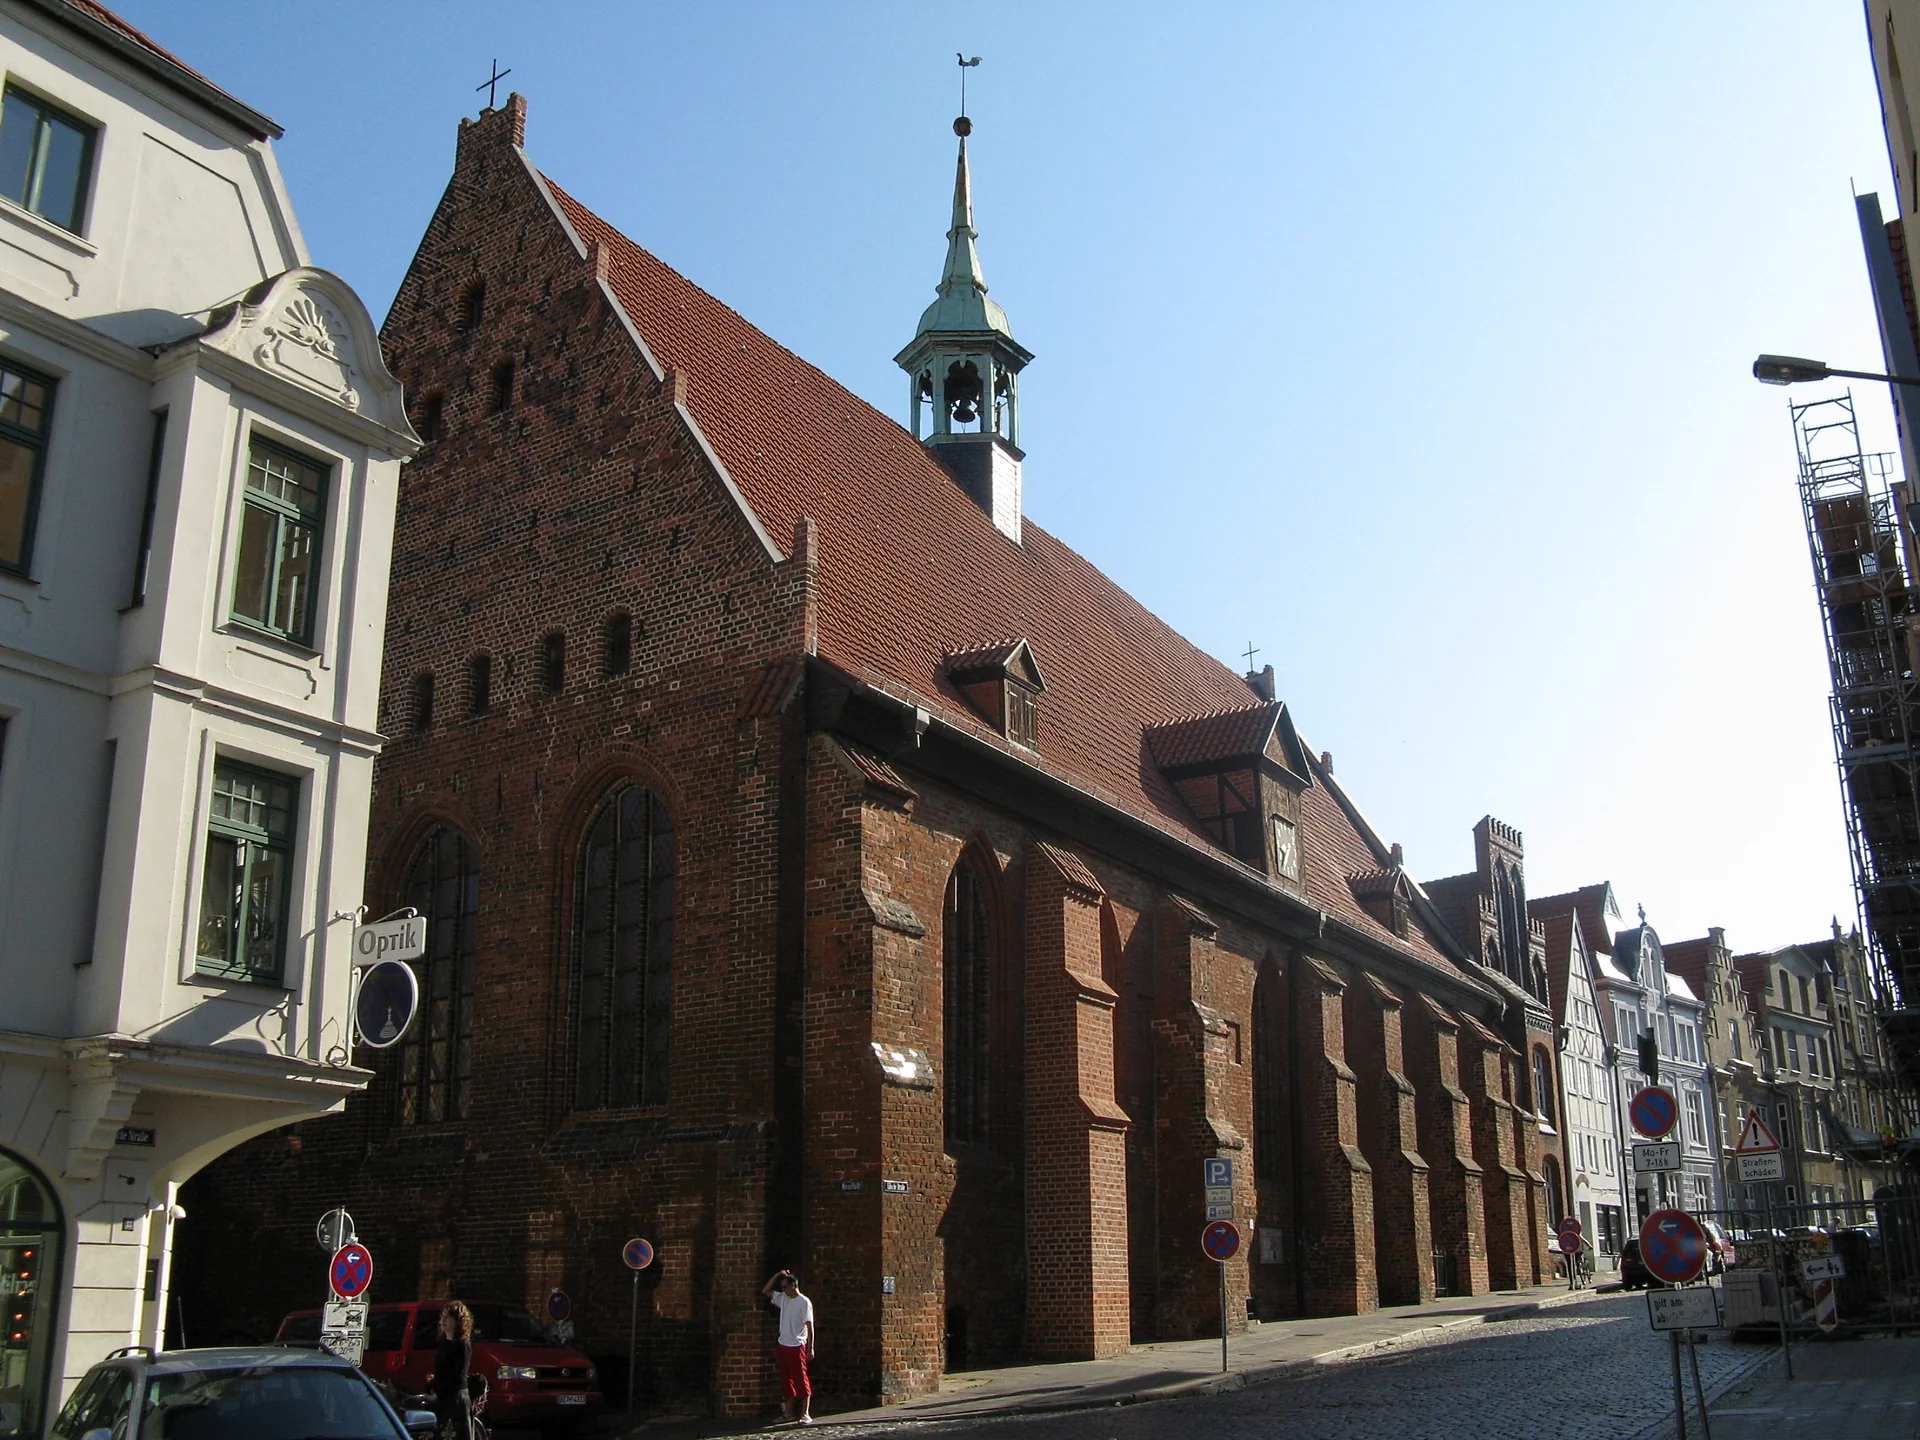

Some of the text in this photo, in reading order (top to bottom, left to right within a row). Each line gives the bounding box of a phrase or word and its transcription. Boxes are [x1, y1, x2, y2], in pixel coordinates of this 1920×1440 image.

[358, 922, 417, 960] Optik
[1642, 1147, 1670, 1157] Mo-Fr
[1645, 1158, 1669, 1168] 7-16h
[1742, 1157, 1777, 1168] Straßen-
[1211, 1162, 1226, 1184] P
[1744, 1167, 1777, 1178] schäden
[1653, 1297, 1668, 1311] gilt
